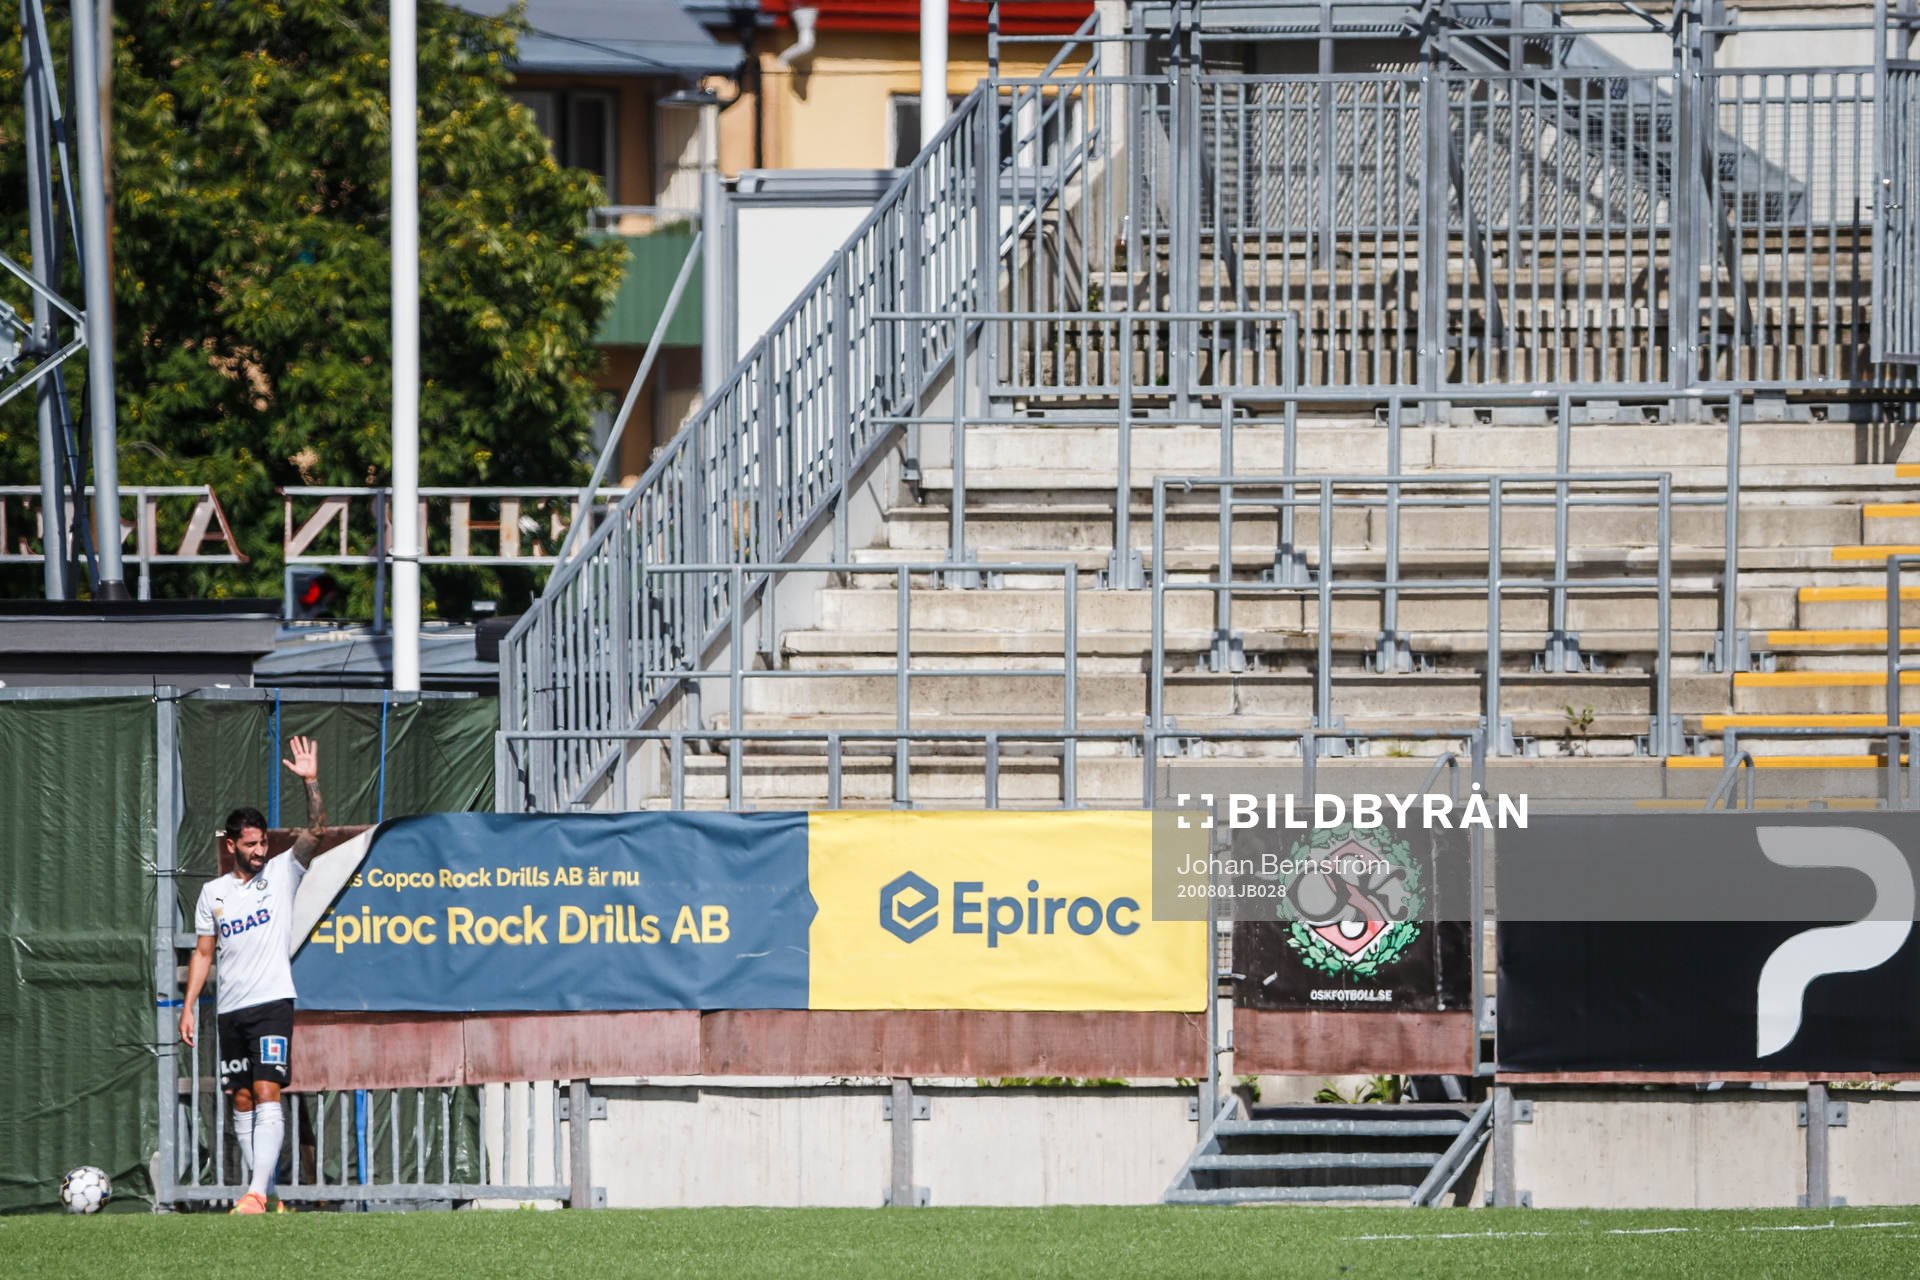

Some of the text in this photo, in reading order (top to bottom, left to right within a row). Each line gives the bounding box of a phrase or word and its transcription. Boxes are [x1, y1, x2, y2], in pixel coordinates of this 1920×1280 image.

[367, 868, 435, 893] Copco
[438, 867, 492, 889] Rock
[496, 866, 550, 888] Drills
[553, 866, 584, 888] AB
[587, 866, 609, 887] är
[612, 869, 641, 887] nu
[220, 908, 271, 938] ÖBAB
[447, 904, 549, 946] Rock
[558, 904, 662, 945] Drills
[669, 904, 731, 945] AB
[952, 879, 1142, 949] Epiroc
